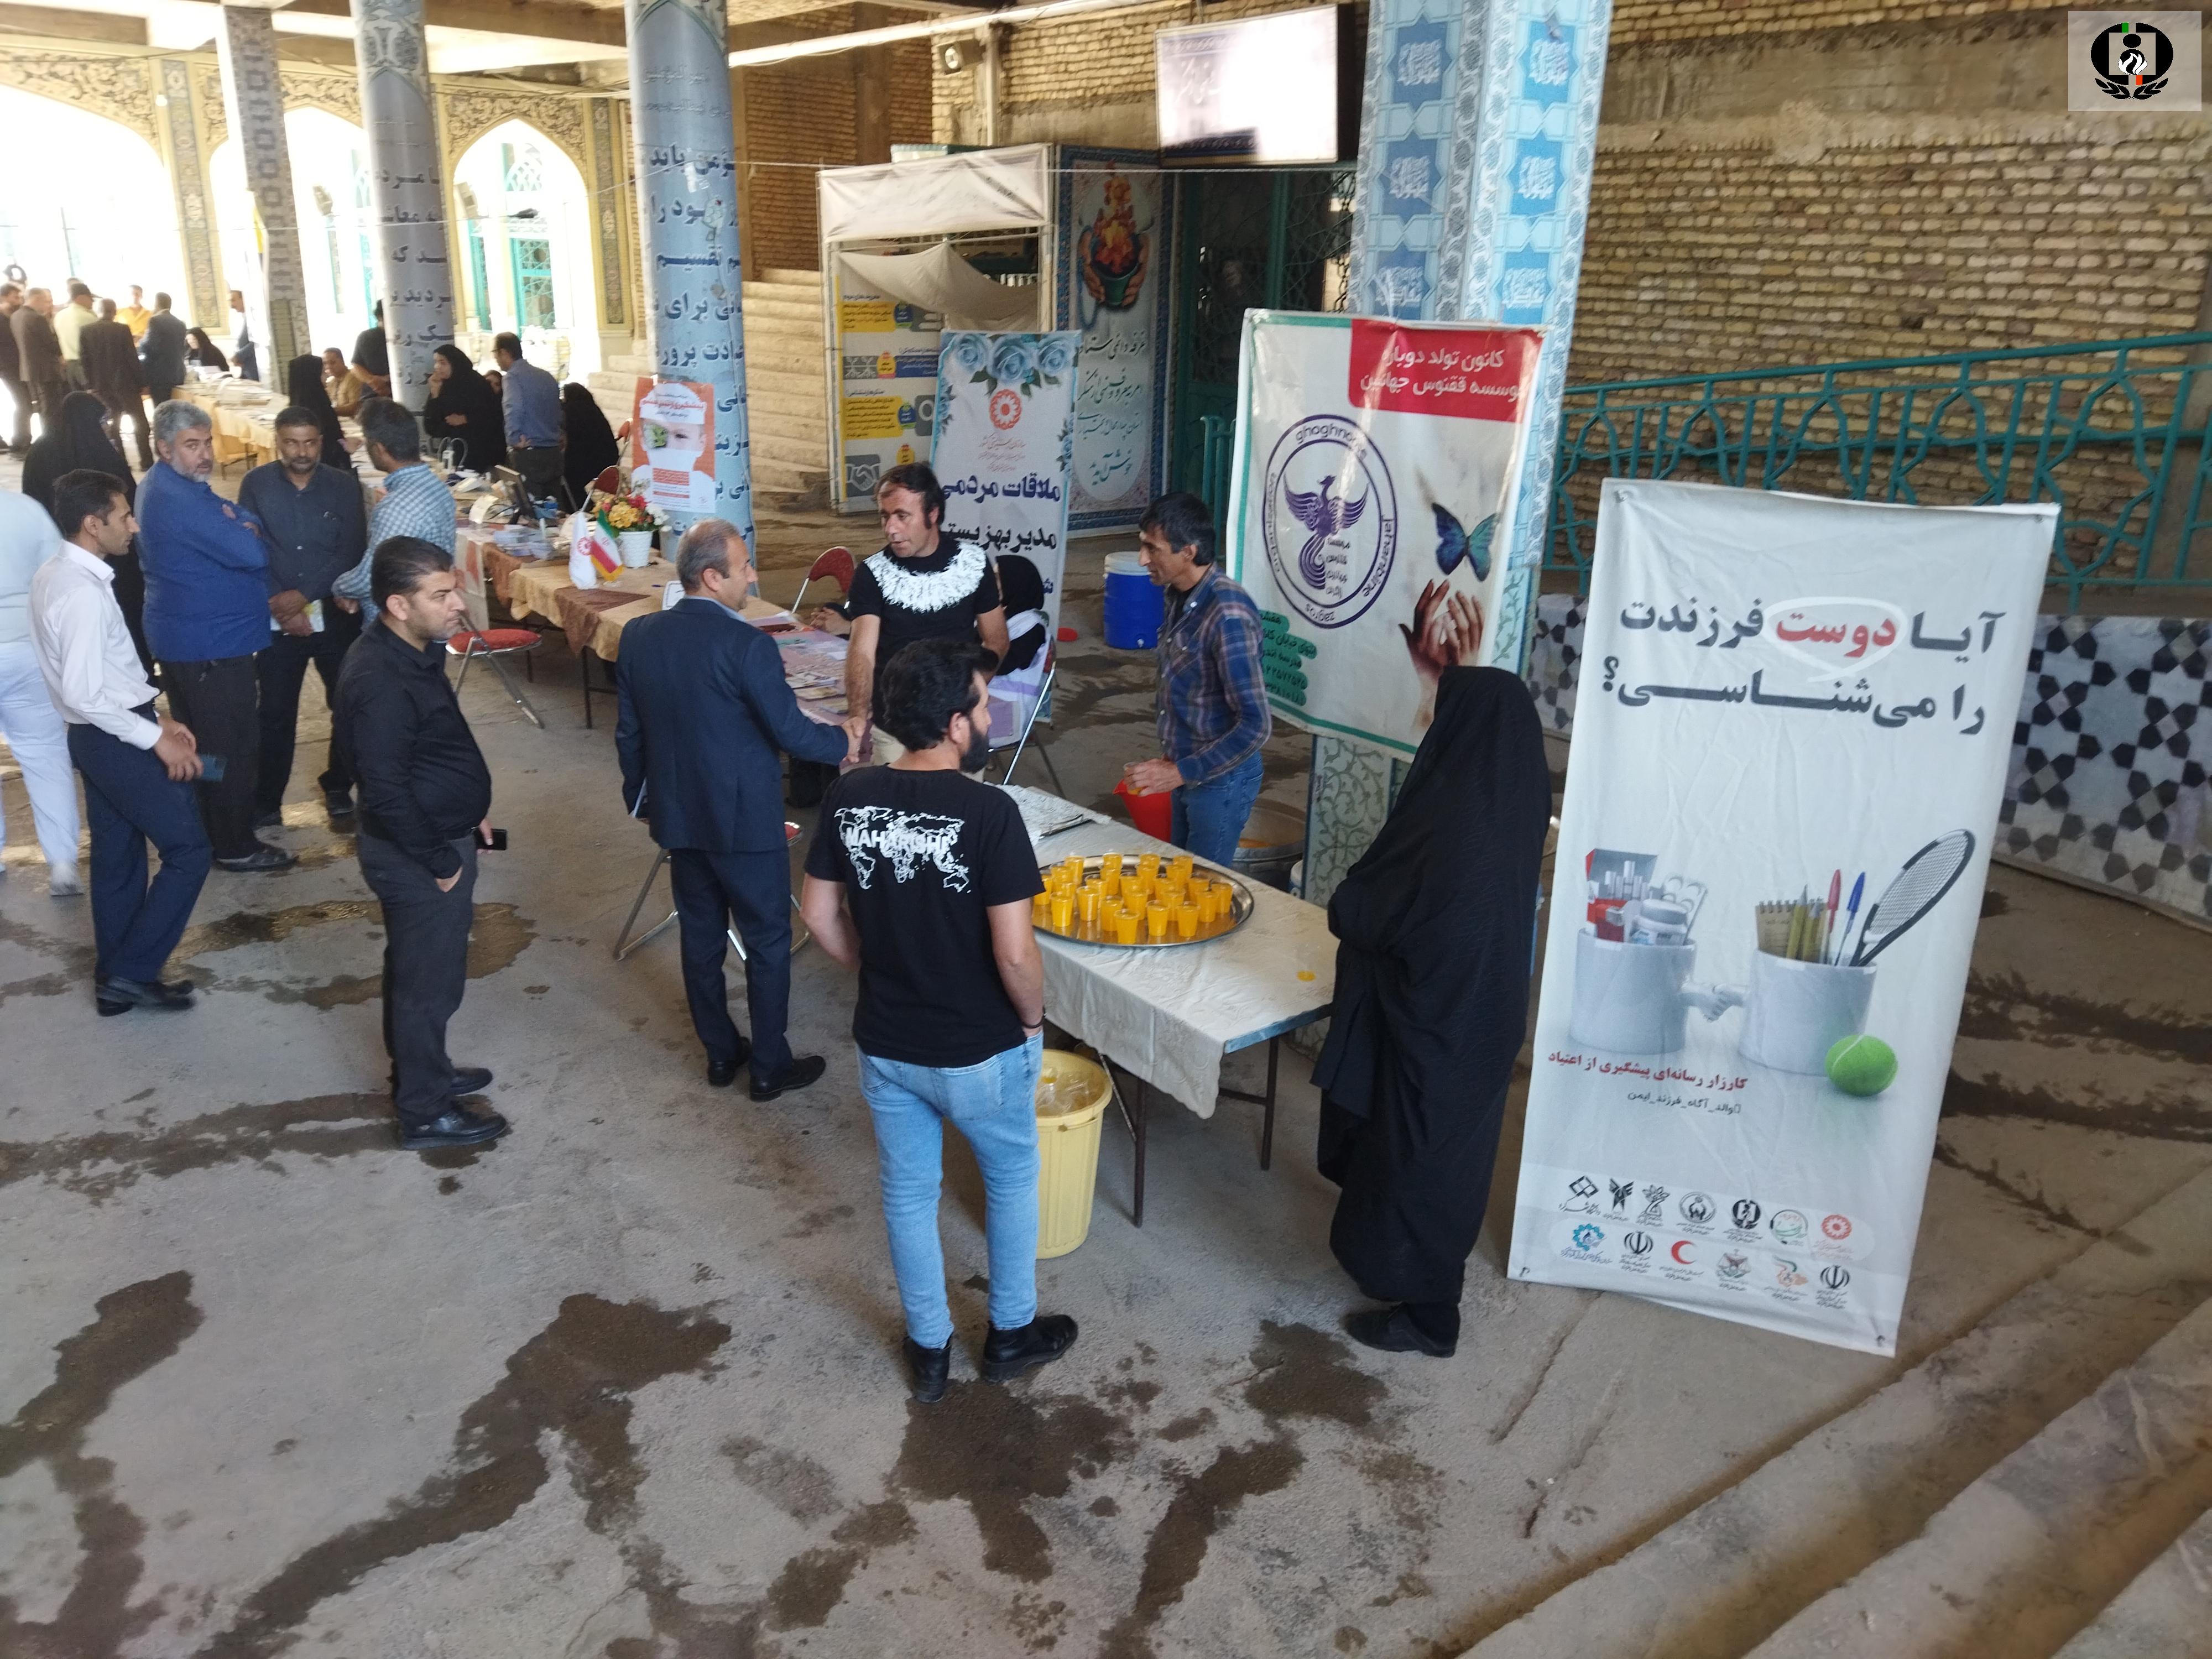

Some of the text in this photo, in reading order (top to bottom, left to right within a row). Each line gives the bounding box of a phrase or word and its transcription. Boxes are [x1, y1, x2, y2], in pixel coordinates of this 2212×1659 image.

[664, 291, 708, 322] برای
[1427, 342, 1460, 371] تولد
[1460, 349, 1505, 373] کانون
[1412, 375, 1467, 397] ققنوس
[1469, 381, 1521, 403] وسسه
[1002, 472, 1061, 502] ملاقات
[940, 522, 1057, 554] مدیر بهزیست
[1620, 598, 2006, 664] آیا دوست فرزندت
[1952, 684, 1985, 735] را
[1548, 1051, 1582, 1067] اعتیاد
[1585, 1056, 1597, 1071] از
[1599, 1061, 1651, 1079] پیشگیری
[1707, 1074, 1748, 1092] کارزار
